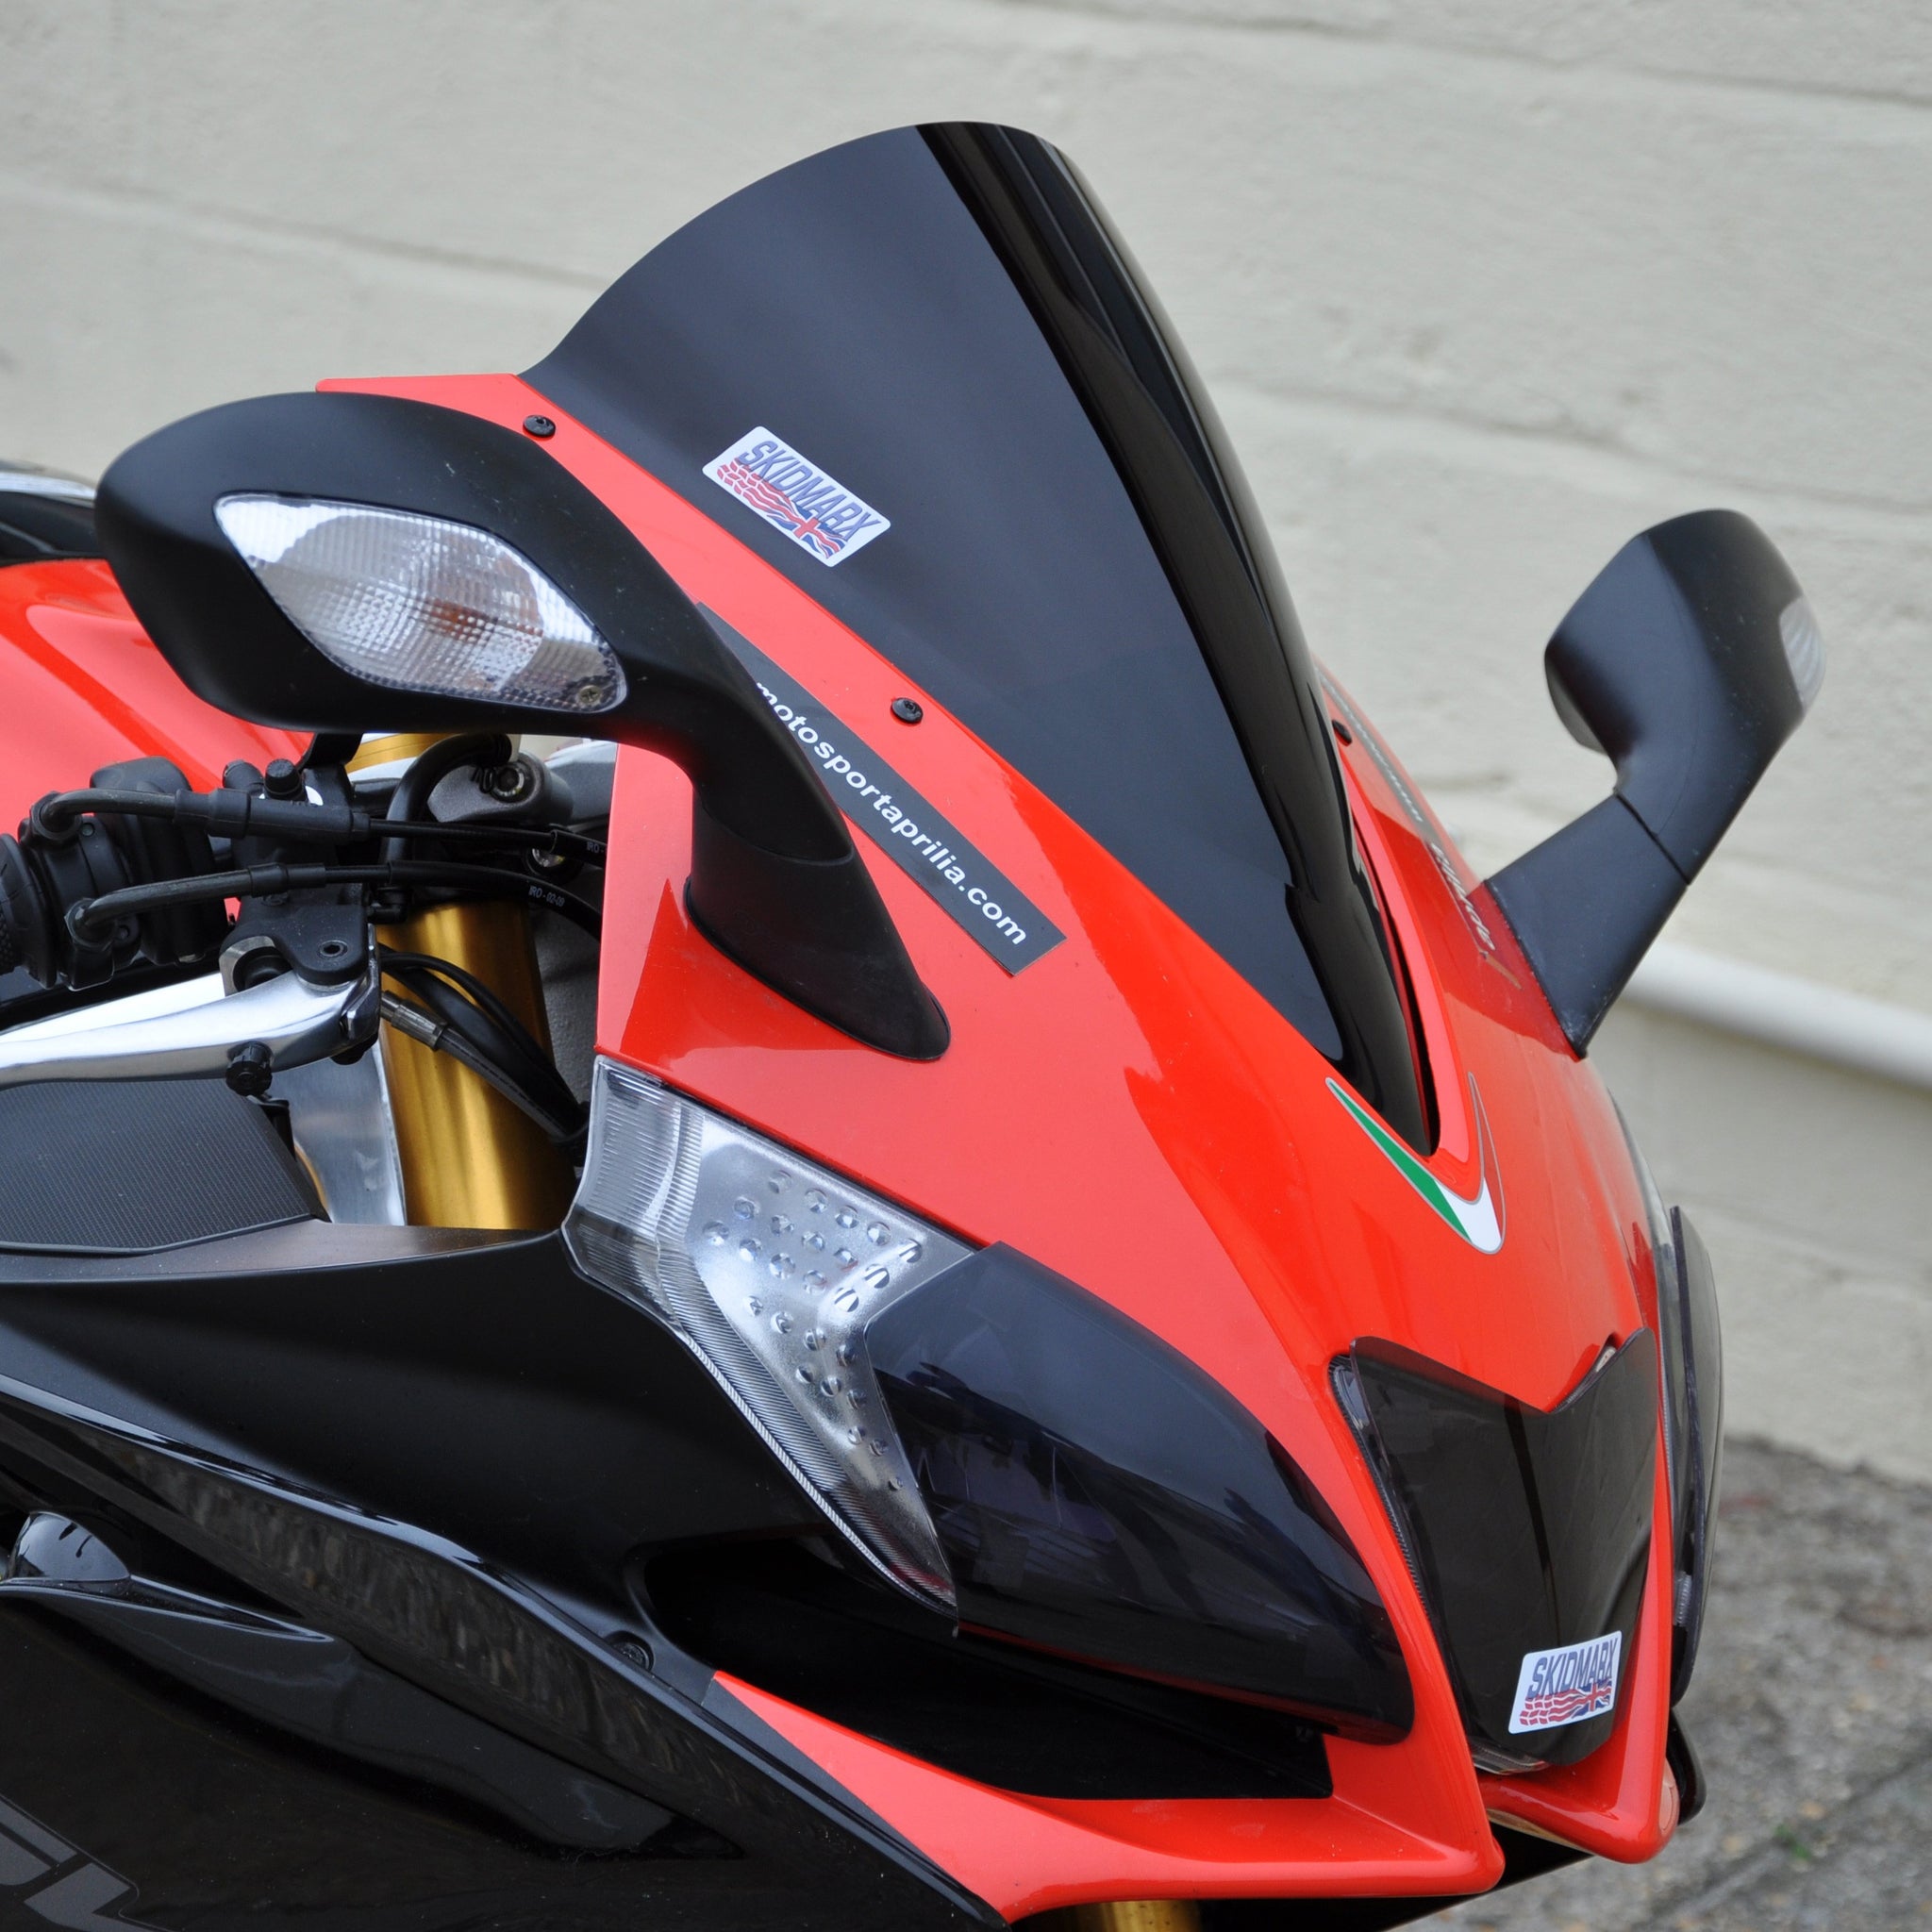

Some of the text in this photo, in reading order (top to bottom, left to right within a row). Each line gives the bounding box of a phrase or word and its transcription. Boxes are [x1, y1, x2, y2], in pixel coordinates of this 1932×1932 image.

[738, 440, 882, 542] SKIDMARX
[756, 681, 1027, 944] motosportaprilia.com
[1526, 1637, 1619, 1699] SKIDMARX
